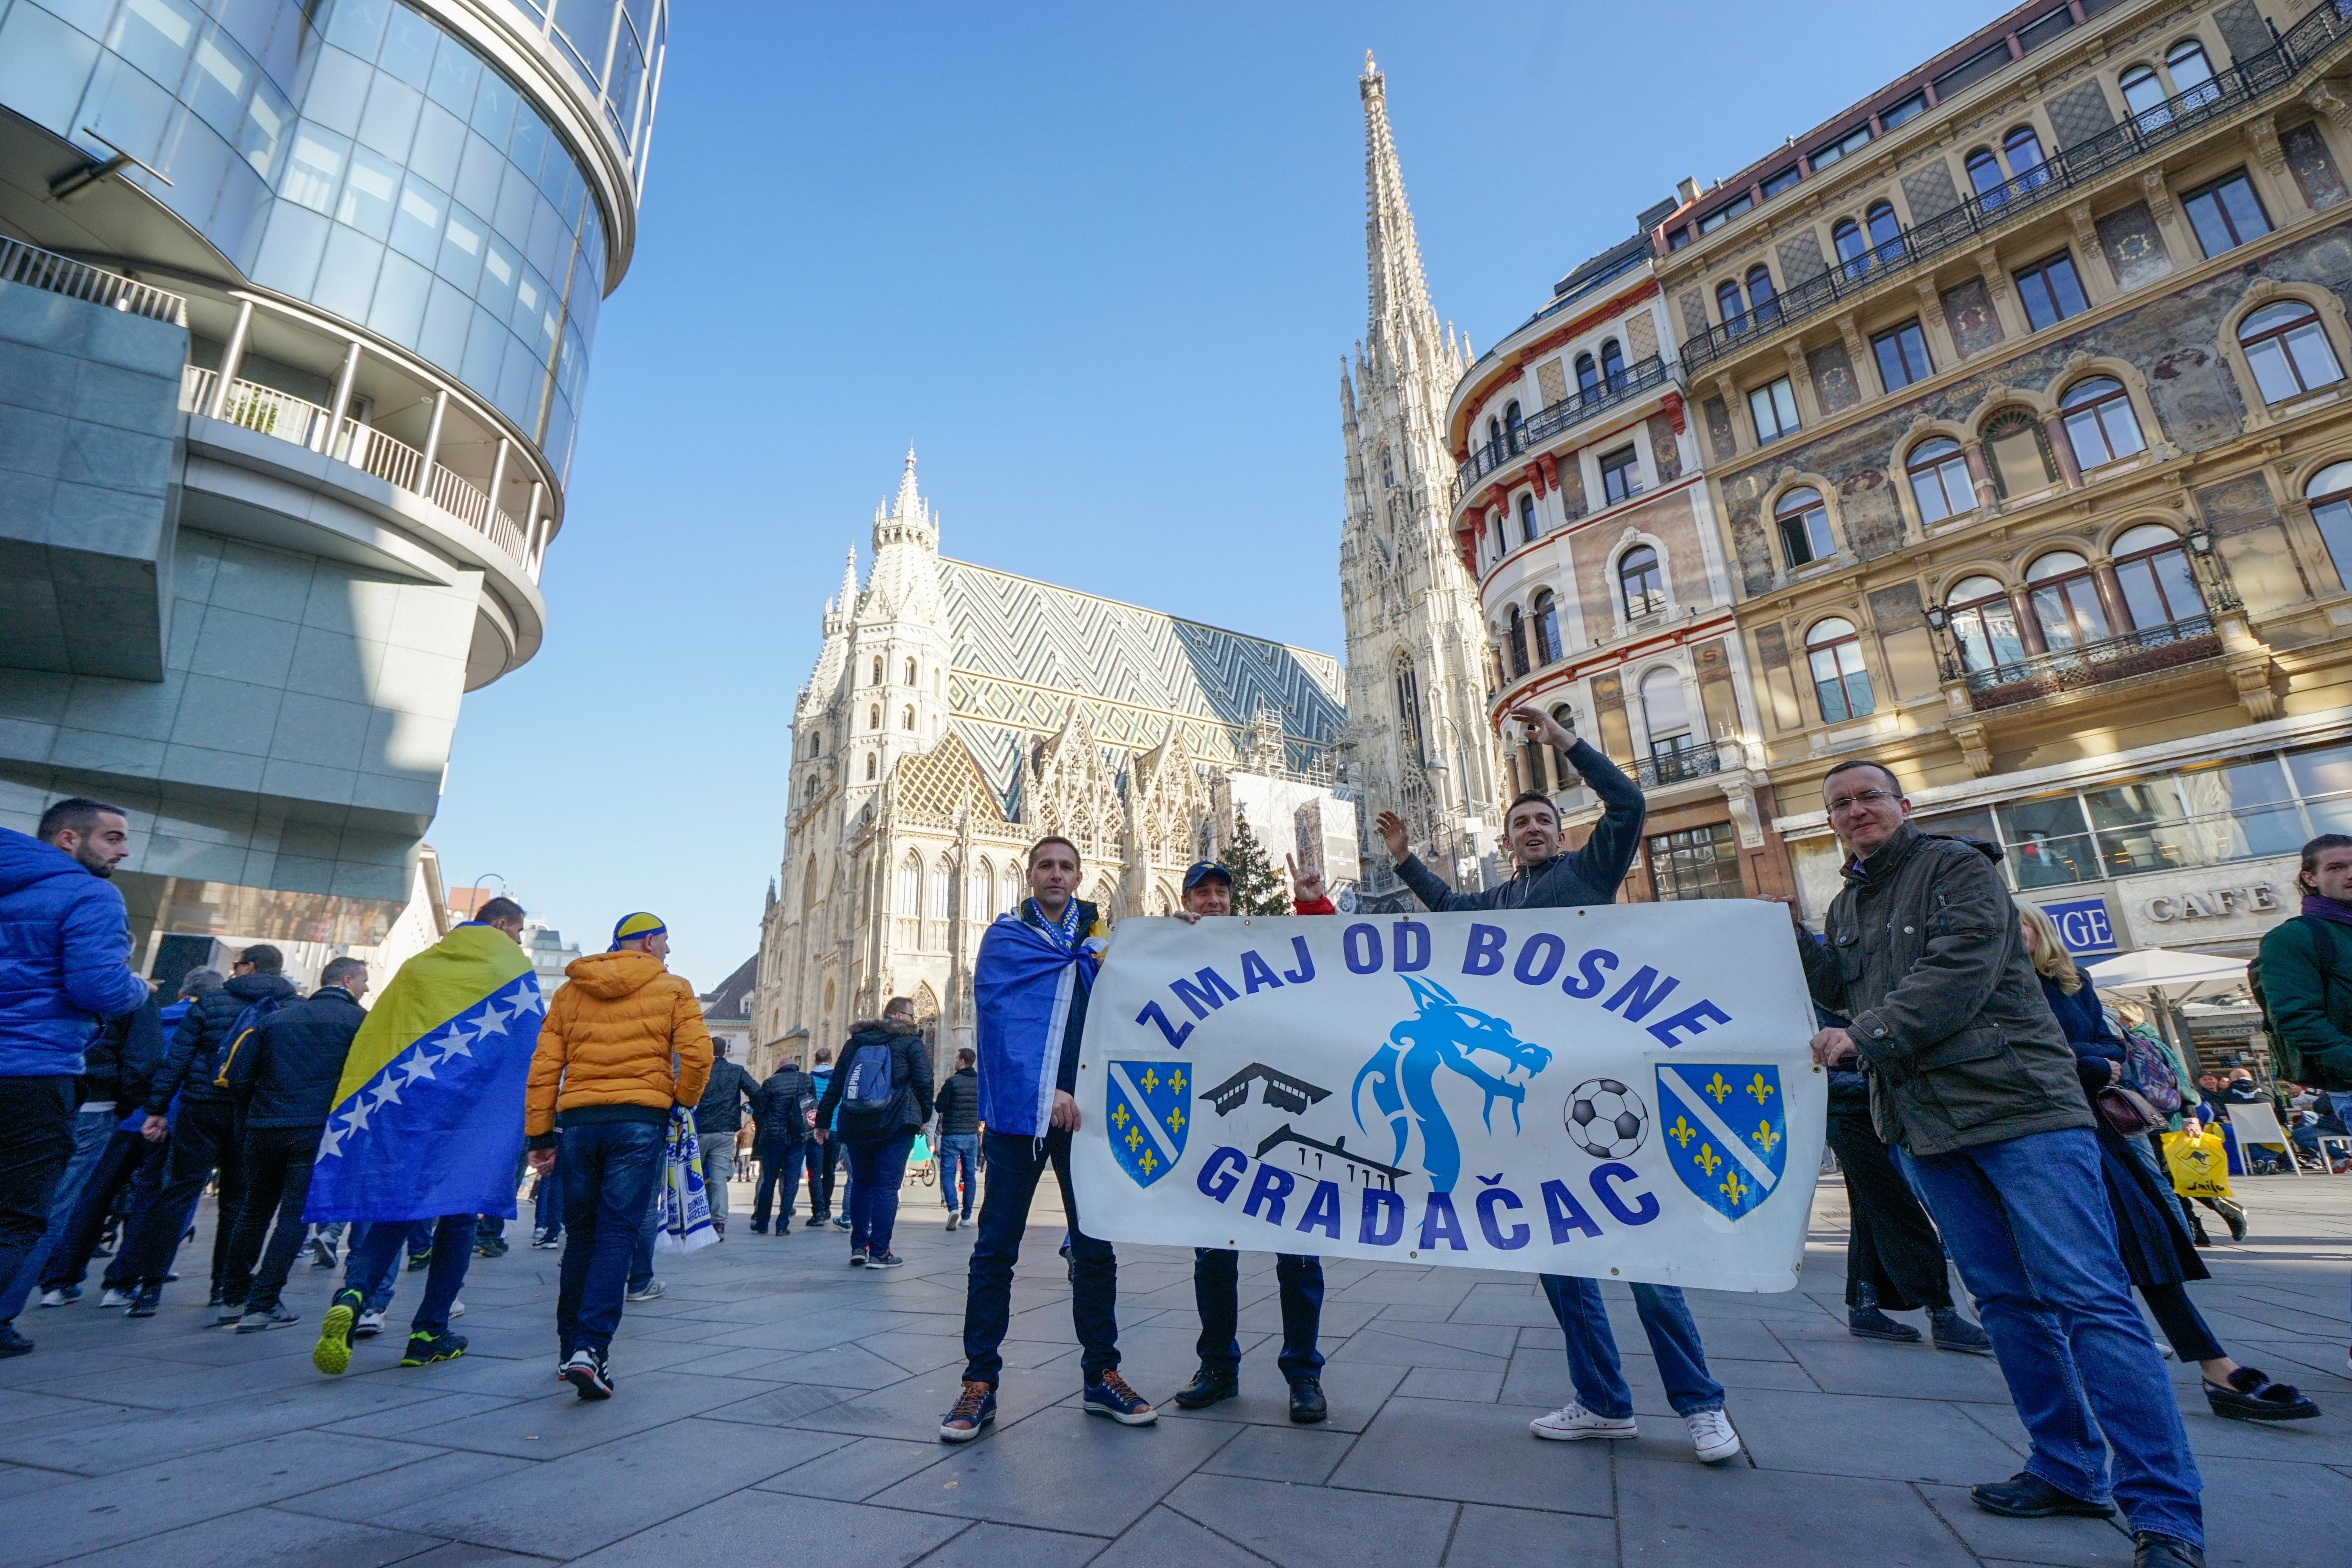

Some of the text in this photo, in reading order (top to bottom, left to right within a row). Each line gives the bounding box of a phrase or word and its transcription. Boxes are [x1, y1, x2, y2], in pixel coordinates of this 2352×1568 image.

[1329, 855, 1355, 863] BREITLING
[2144, 880, 2277, 922] CAFÉ
[1135, 921, 1733, 1050] ZMAJ OD BOSNE
[849, 1063, 862, 1085] PUMA
[1196, 1146, 1660, 1251] GRADAČAC
